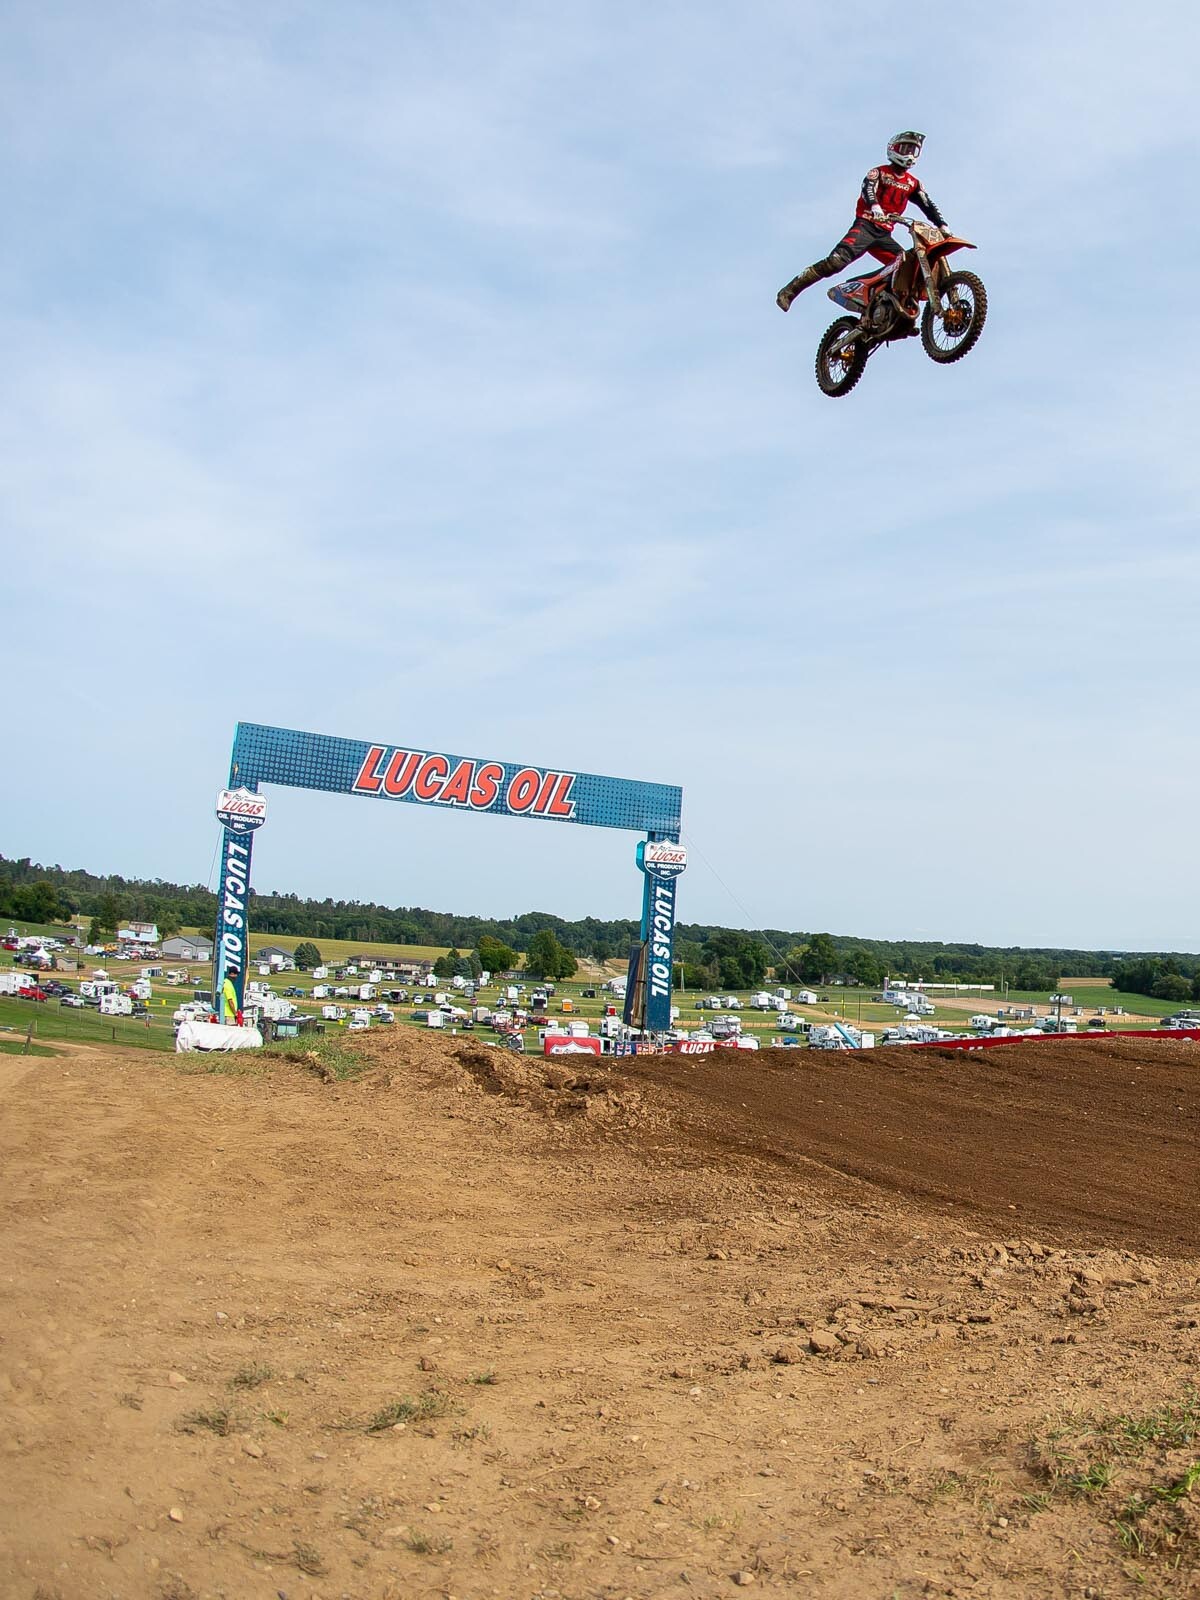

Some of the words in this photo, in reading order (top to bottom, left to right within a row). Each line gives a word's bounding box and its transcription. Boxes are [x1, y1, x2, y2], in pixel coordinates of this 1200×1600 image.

[352, 745, 504, 810] LUCAS
[506, 767, 577, 820] OIL
[217, 812, 230, 820] OIL
[230, 815, 264, 825] PRODUCTS
[222, 800, 265, 815] LUCAS
[650, 851, 685, 863] LUCAS
[657, 863, 685, 871] PRODUCTS
[223, 841, 249, 929] LUCAS
[653, 886, 673, 960] LUCAS
[651, 963, 670, 997] OIL
